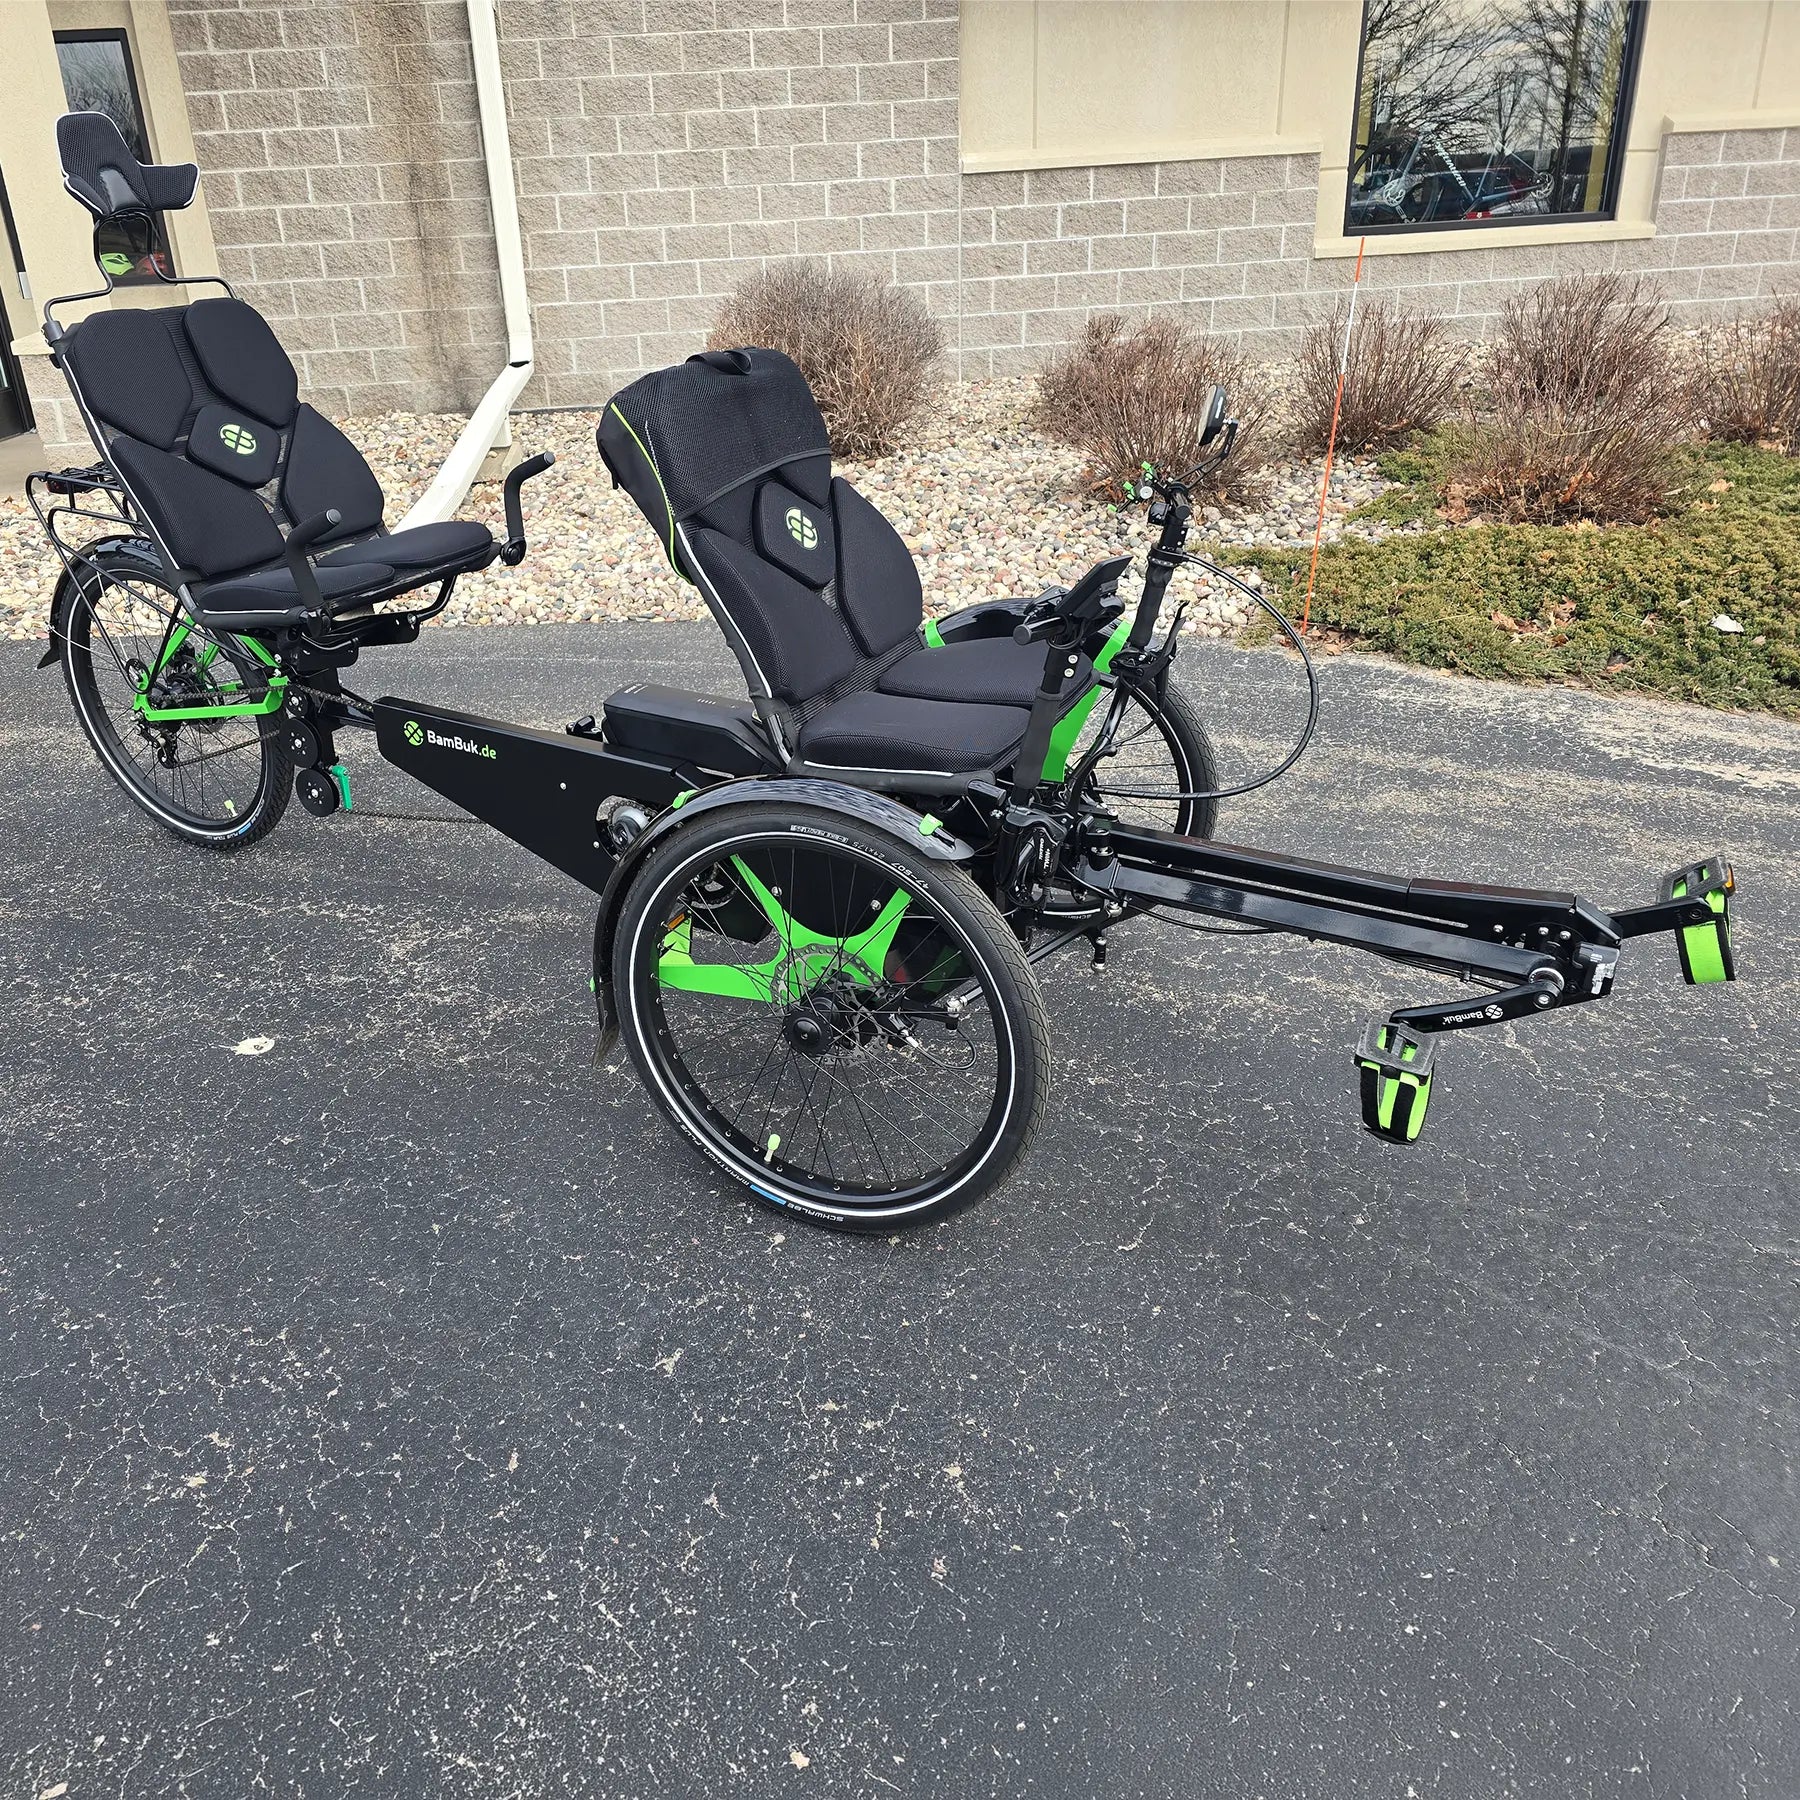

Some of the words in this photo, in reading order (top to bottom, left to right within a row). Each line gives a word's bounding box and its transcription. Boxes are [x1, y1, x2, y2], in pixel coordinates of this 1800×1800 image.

[426, 729, 497, 759] BamBuk.de
[680, 1123, 702, 1146] PLUS
[703, 1149, 750, 1186] MARATHON
